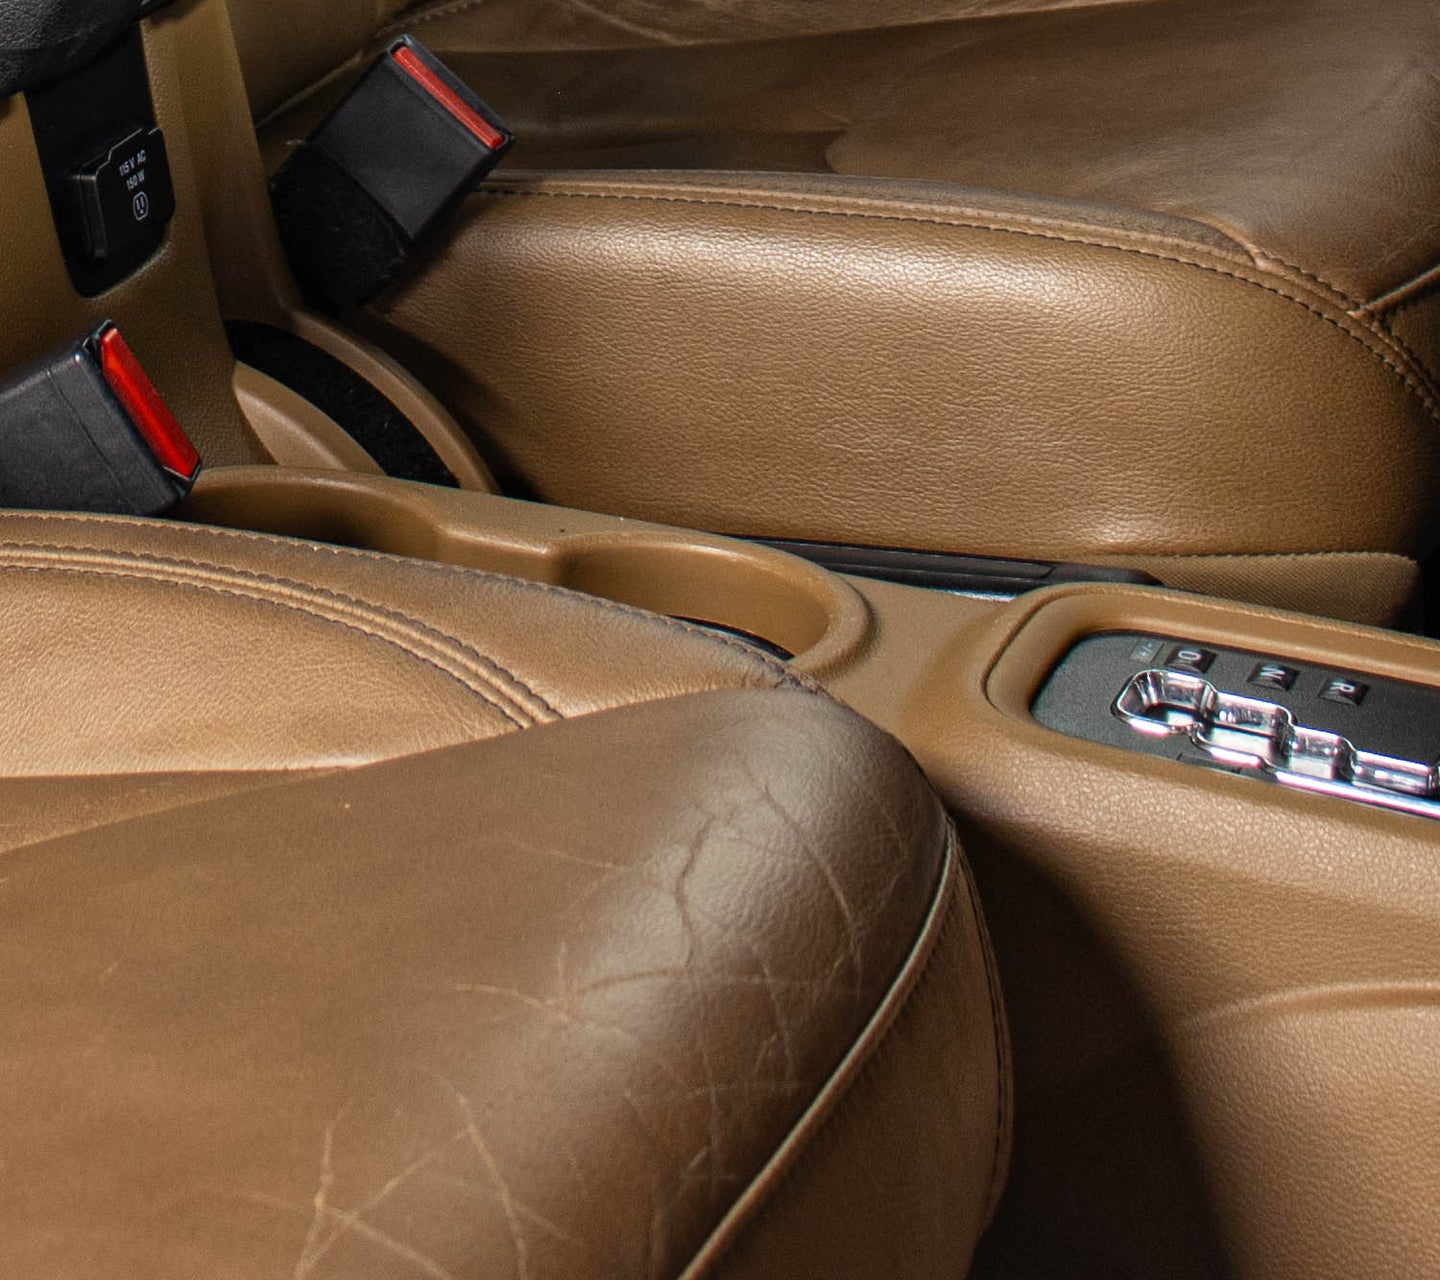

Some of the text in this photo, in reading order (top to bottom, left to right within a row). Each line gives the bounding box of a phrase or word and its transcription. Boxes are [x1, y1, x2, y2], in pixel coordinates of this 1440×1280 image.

[119, 149, 146, 177] 115 V AC
[126, 168, 145, 191] 150 W
[1177, 649, 1202, 661] D
[1259, 665, 1286, 681] N
[1330, 680, 1356, 693] R
